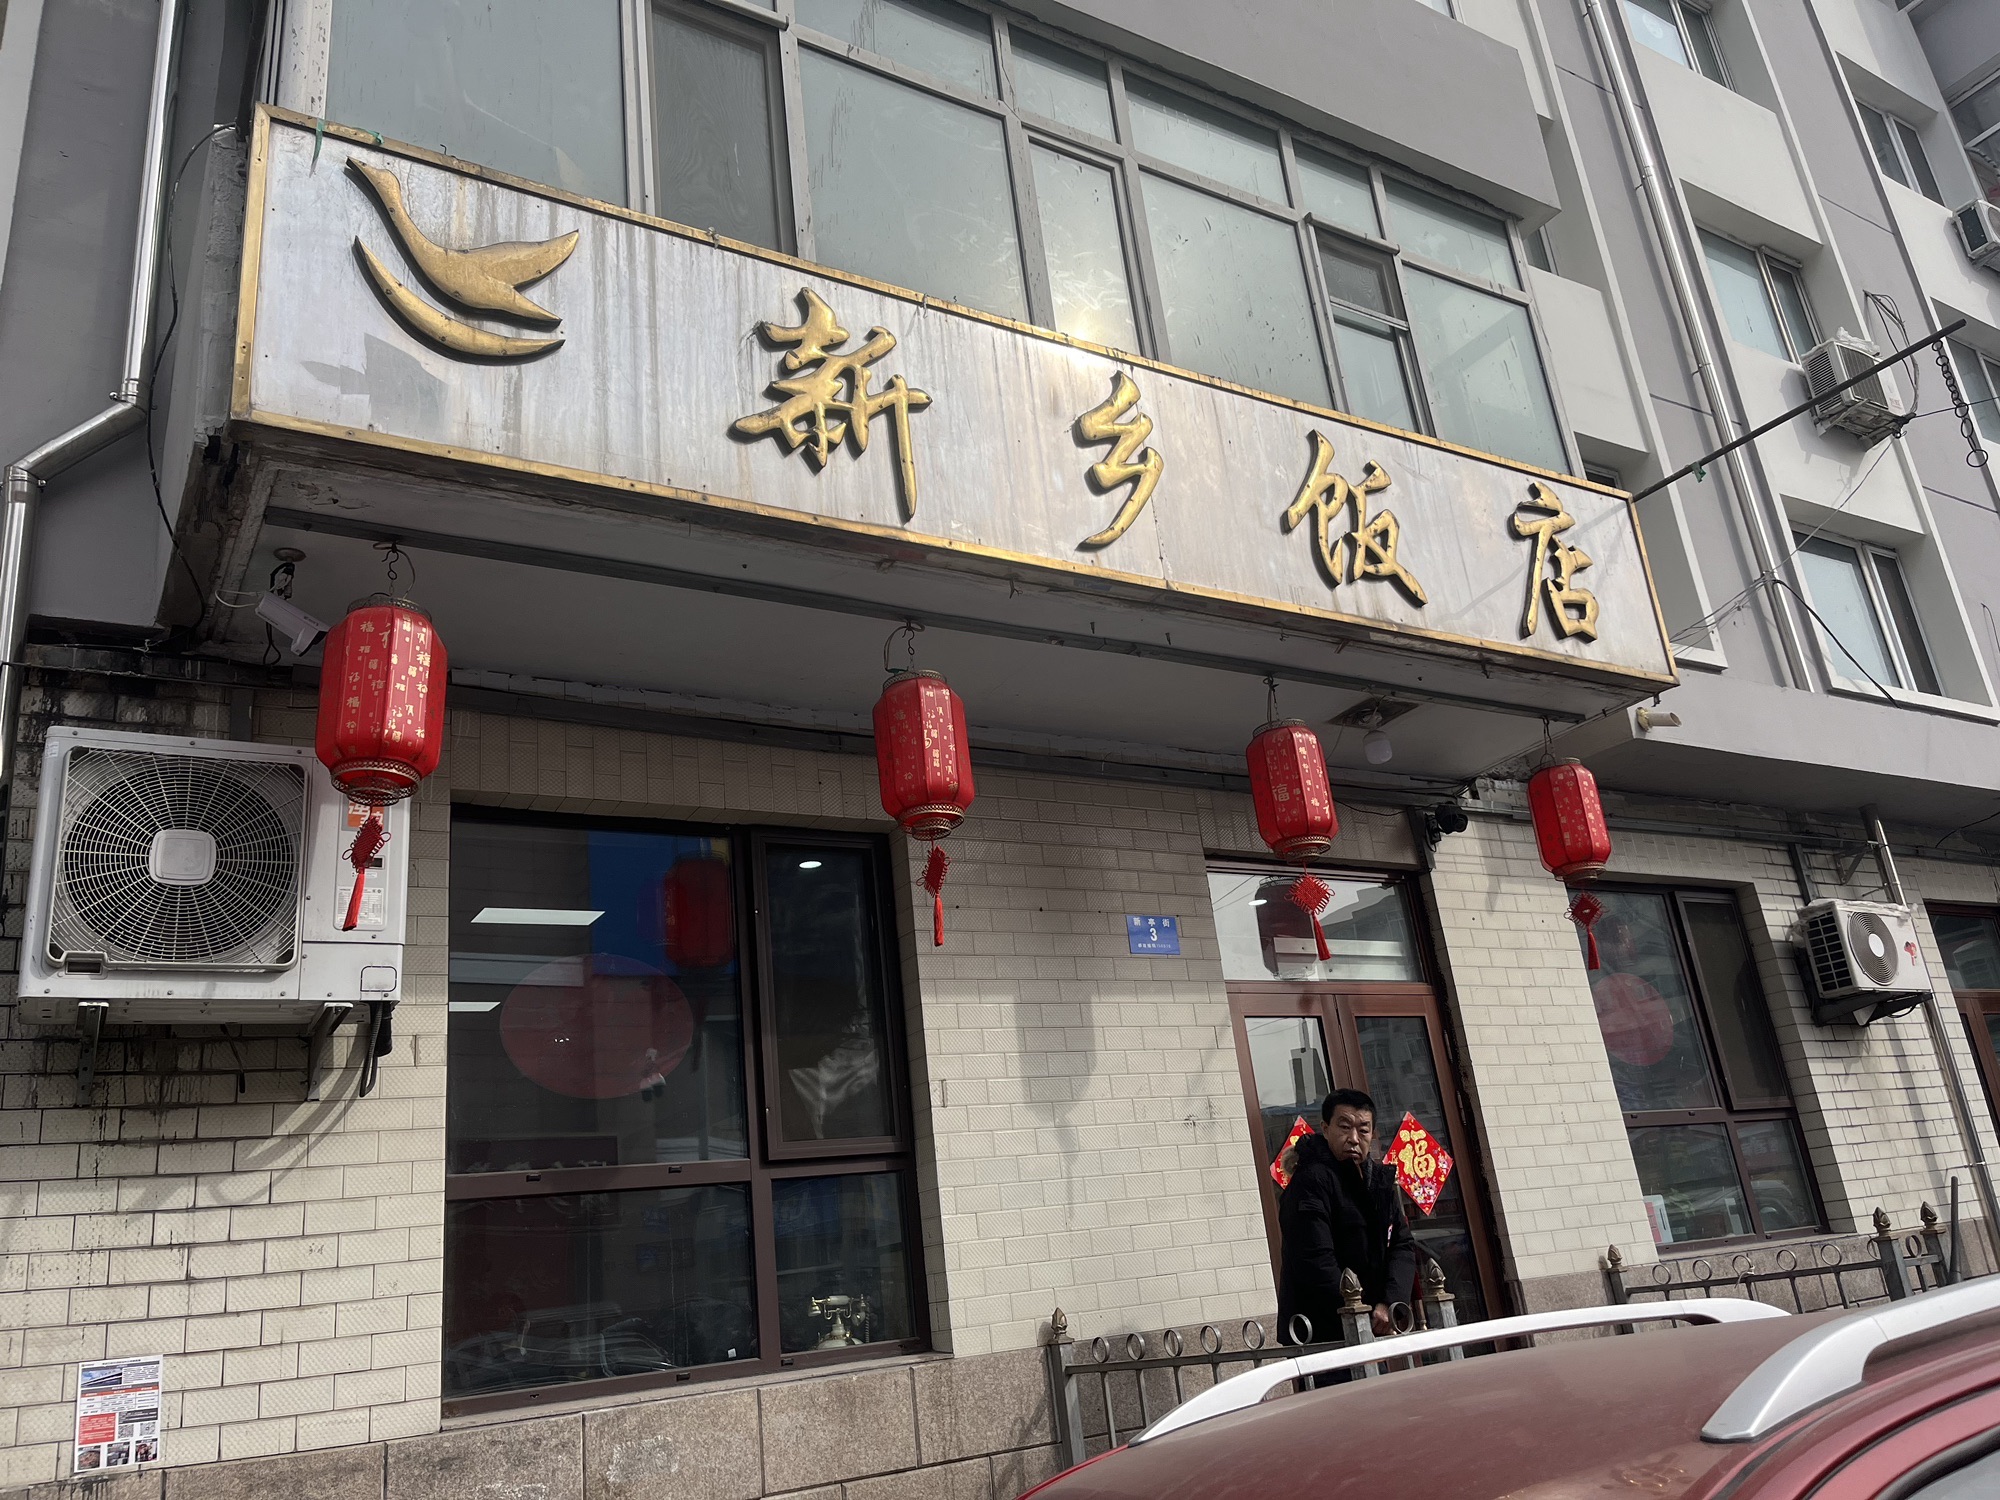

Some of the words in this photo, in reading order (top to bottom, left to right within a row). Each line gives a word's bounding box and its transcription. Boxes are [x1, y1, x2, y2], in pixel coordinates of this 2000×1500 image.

[730, 286, 1600, 642] 新乡饭店
[1149, 928, 1158, 941] 3
[1399, 1129, 1437, 1179] 福
